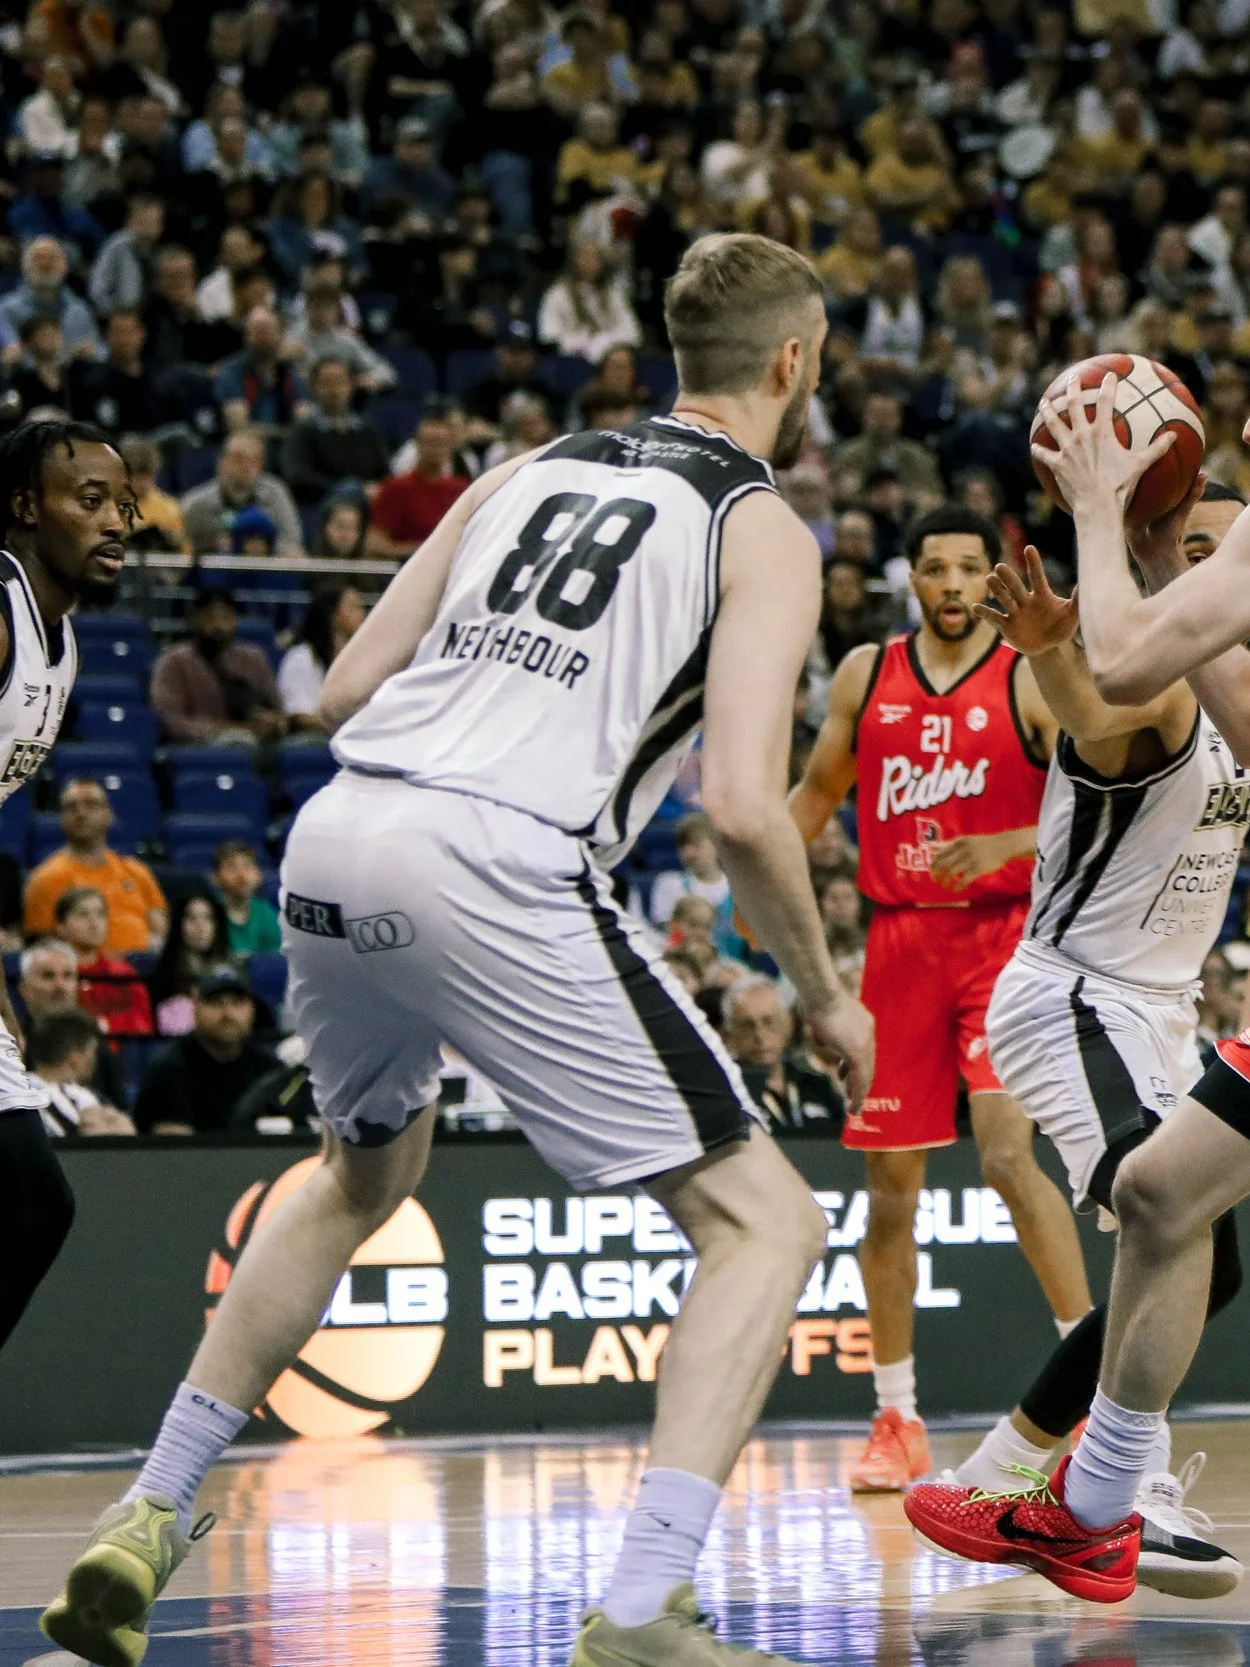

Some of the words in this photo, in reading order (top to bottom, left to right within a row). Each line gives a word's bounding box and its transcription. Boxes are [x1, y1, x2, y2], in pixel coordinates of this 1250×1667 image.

[486, 491, 658, 632] 88
[440, 622, 590, 690] NEIHBOUR
[921, 713, 953, 754] 21
[876, 753, 991, 822] Riders
[863, 1096, 901, 1112] ERTU
[482, 1195, 693, 1257] SUPE
[810, 1186, 1019, 1247] AUE
[319, 1266, 450, 1328] LB
[482, 1251, 961, 1323] BASKAL
[482, 1317, 874, 1389] PLAYFS
